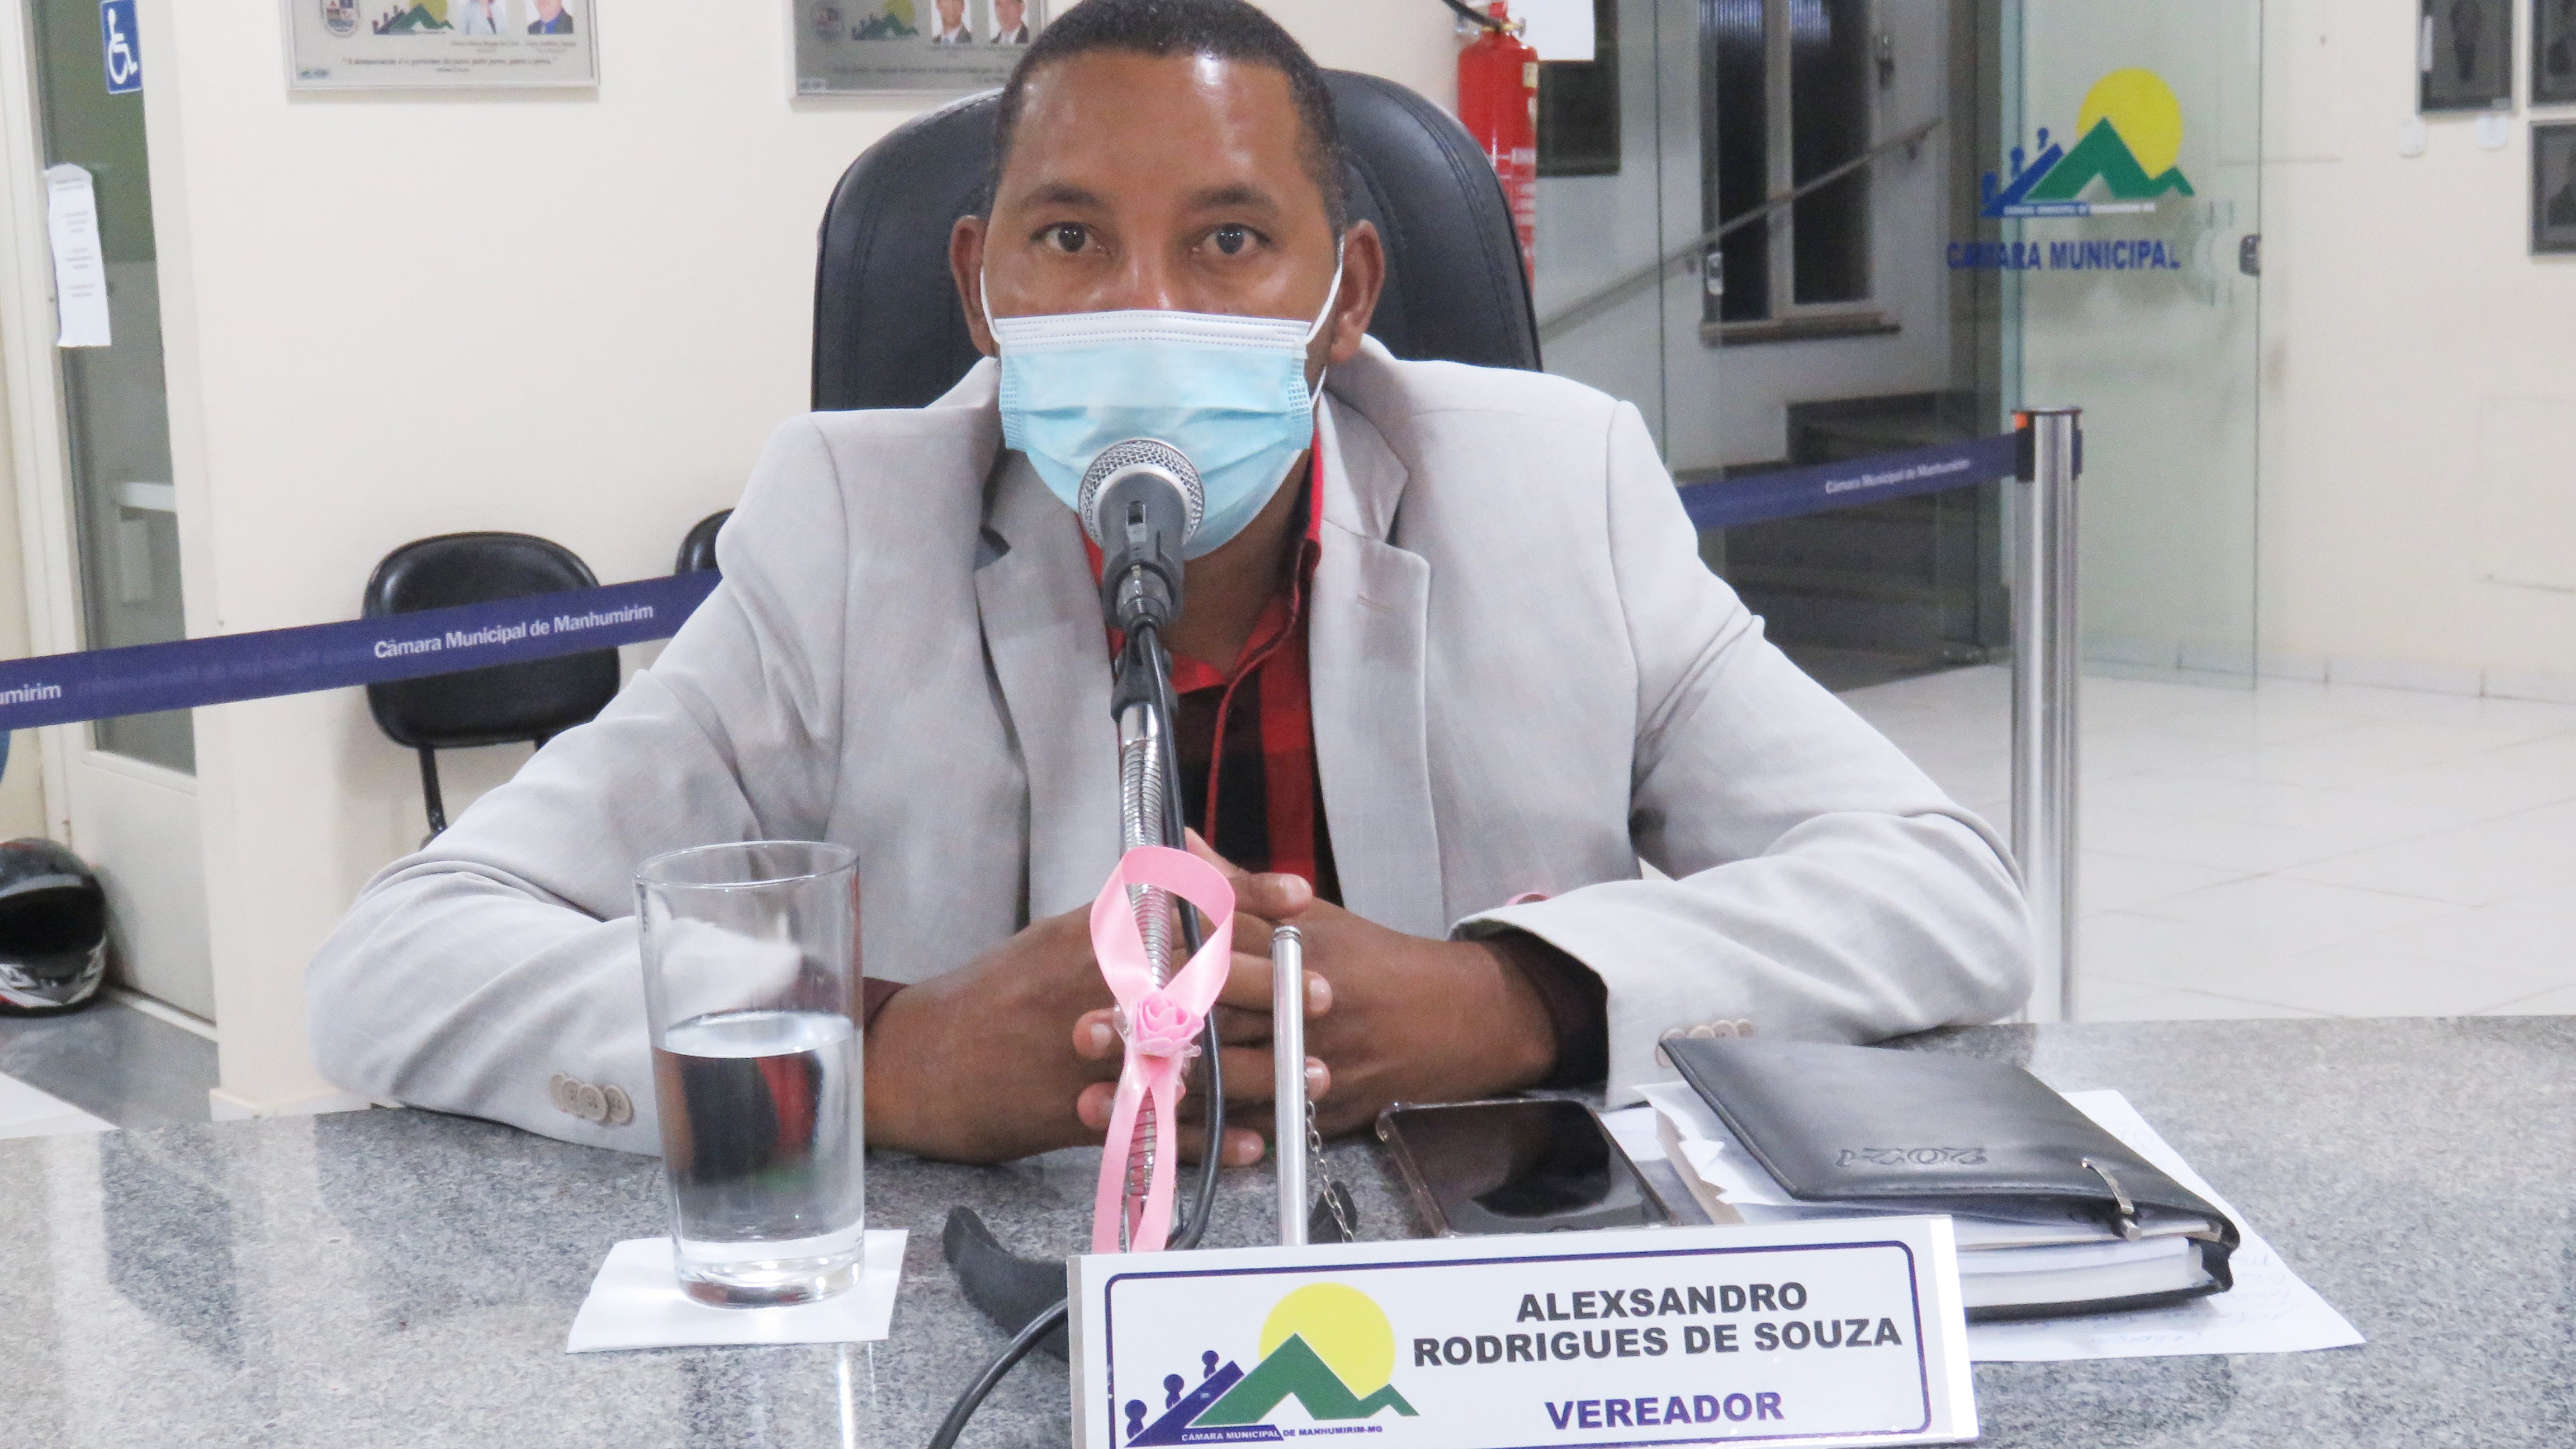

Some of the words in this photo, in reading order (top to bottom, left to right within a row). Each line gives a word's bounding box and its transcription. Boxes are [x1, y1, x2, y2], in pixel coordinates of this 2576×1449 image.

[2049, 239, 2180, 271] MUNICIPAL
[375, 638, 442, 659] Câmara
[445, 622, 526, 649] Municipal
[529, 621, 550, 637] de
[553, 604, 654, 633] Manhumirim
[1516, 1282, 1807, 1323] ALEXSANDRO
[1413, 1327, 1669, 1367] RODRIGUES
[1683, 1324, 1740, 1355] DE
[1754, 1317, 1903, 1352] SOUZA
[1545, 1391, 1786, 1431] VEREADOR
[1225, 1429, 1281, 1441] MUNICIPAL
[1282, 1429, 1296, 1437] DE
[1298, 1425, 1384, 1437] MANHUMIRIM-MG
